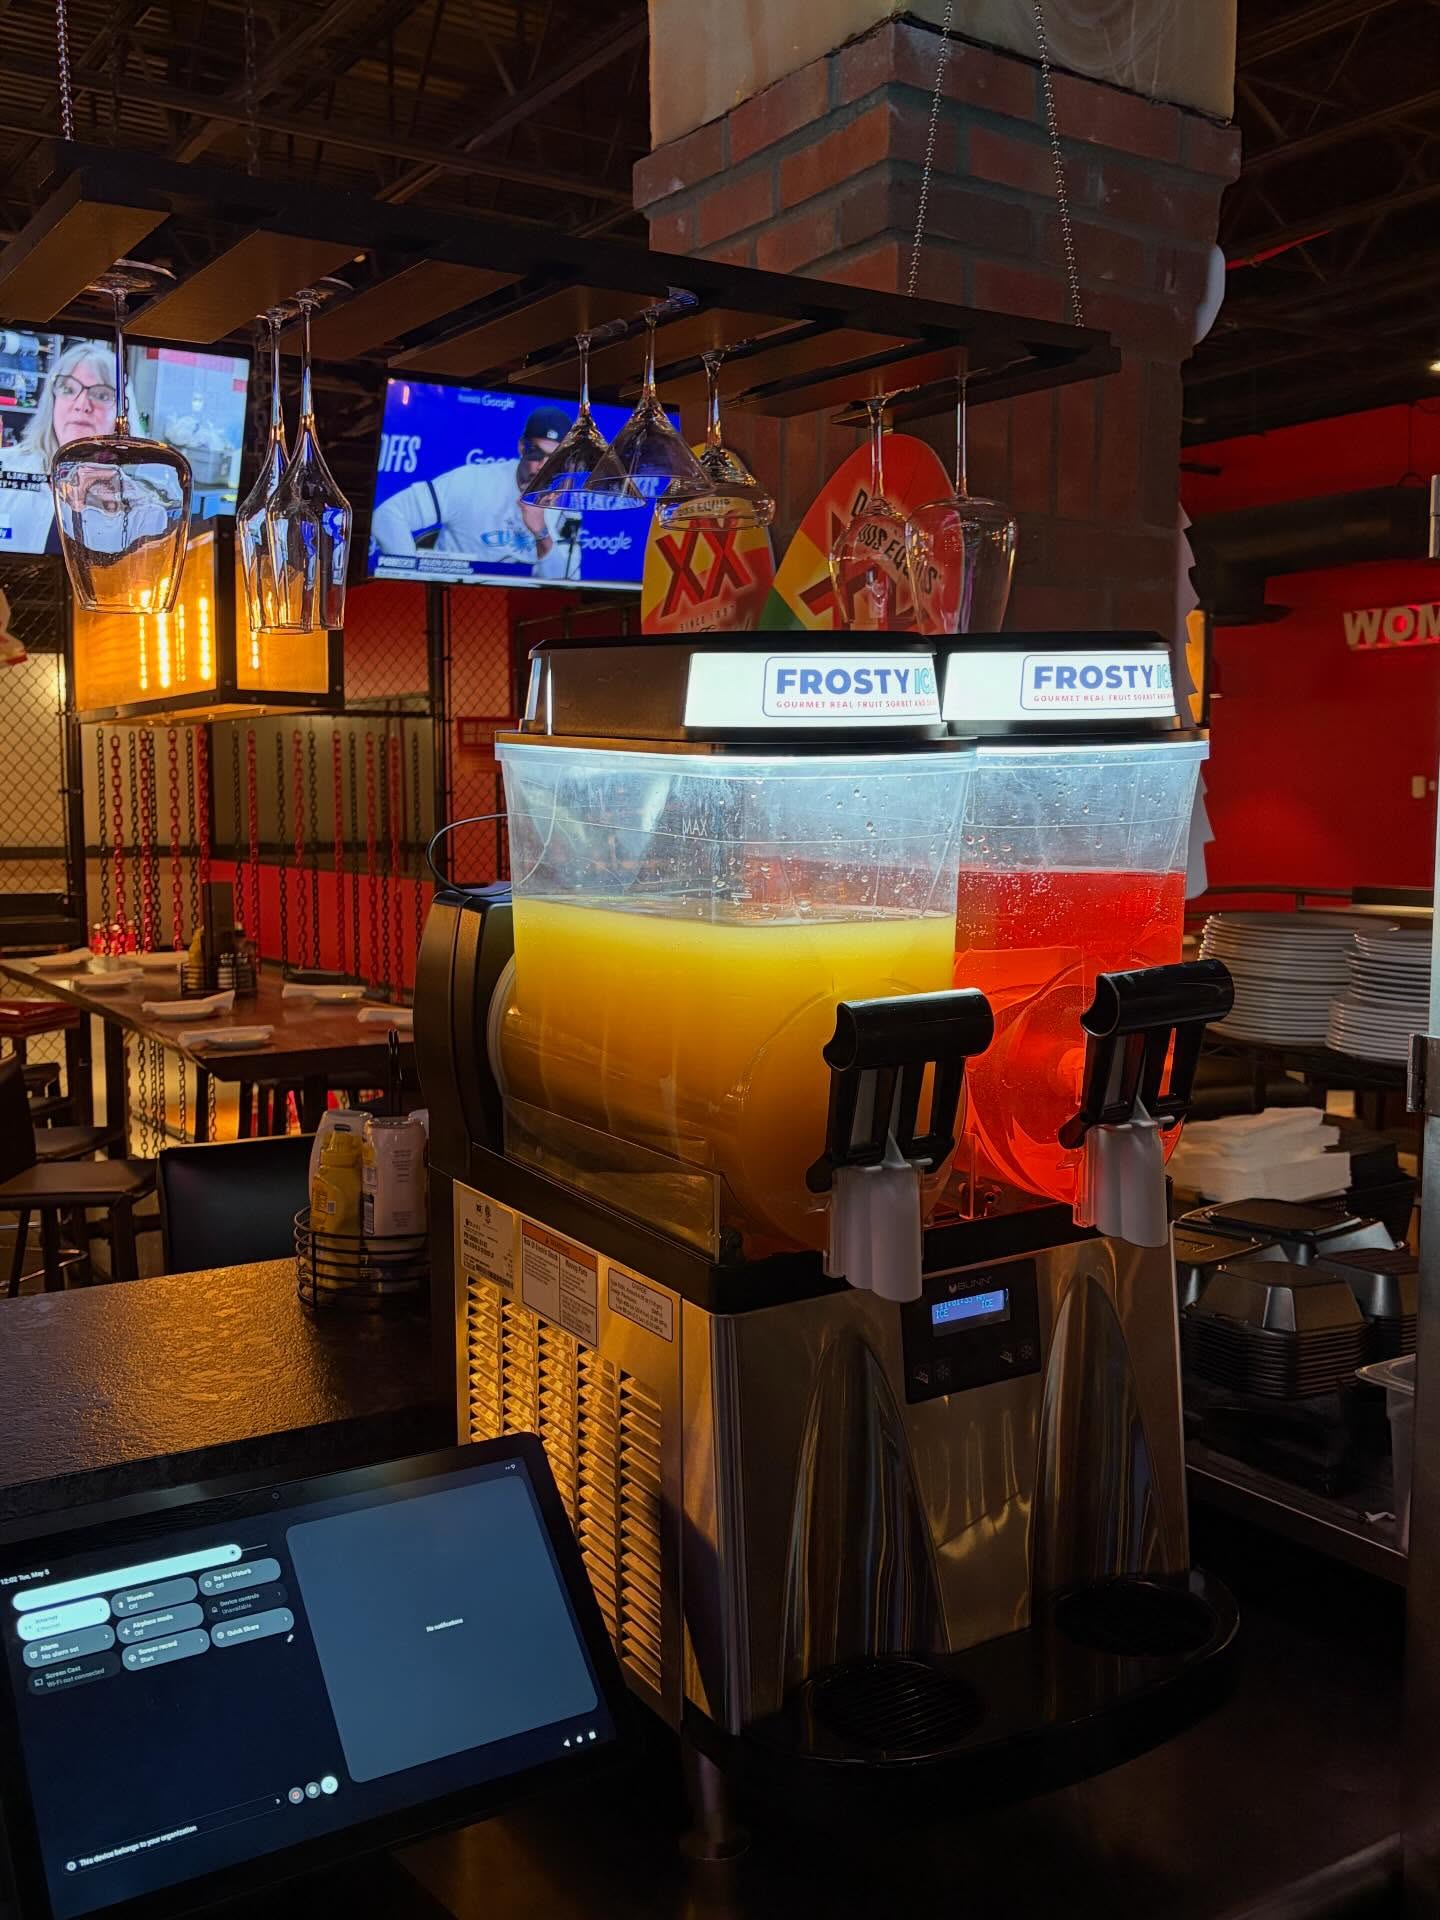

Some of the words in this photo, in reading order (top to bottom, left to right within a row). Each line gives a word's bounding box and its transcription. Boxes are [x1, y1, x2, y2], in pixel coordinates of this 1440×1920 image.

[578, 531, 632, 555] Google
[655, 512, 753, 618] XX
[776, 669, 909, 695] FROSTY
[1033, 665, 1153, 689] FROSTY
[776, 700, 826, 709] GOURMET
[830, 700, 853, 709] REAL
[858, 700, 883, 709] FRUIT
[1033, 695, 1080, 703] GOURMET
[935, 1309, 949, 1319] ICE
[981, 1299, 993, 1309] ICE
[220, 1599, 237, 1607] Device
[238, 1592, 260, 1602] controls
[226, 1627, 243, 1637] Quick
[243, 1624, 260, 1633] Share
[45, 1669, 66, 1679] Screen
[66, 1665, 81, 1674] Cast
[74, 1668, 105, 1680] connected
